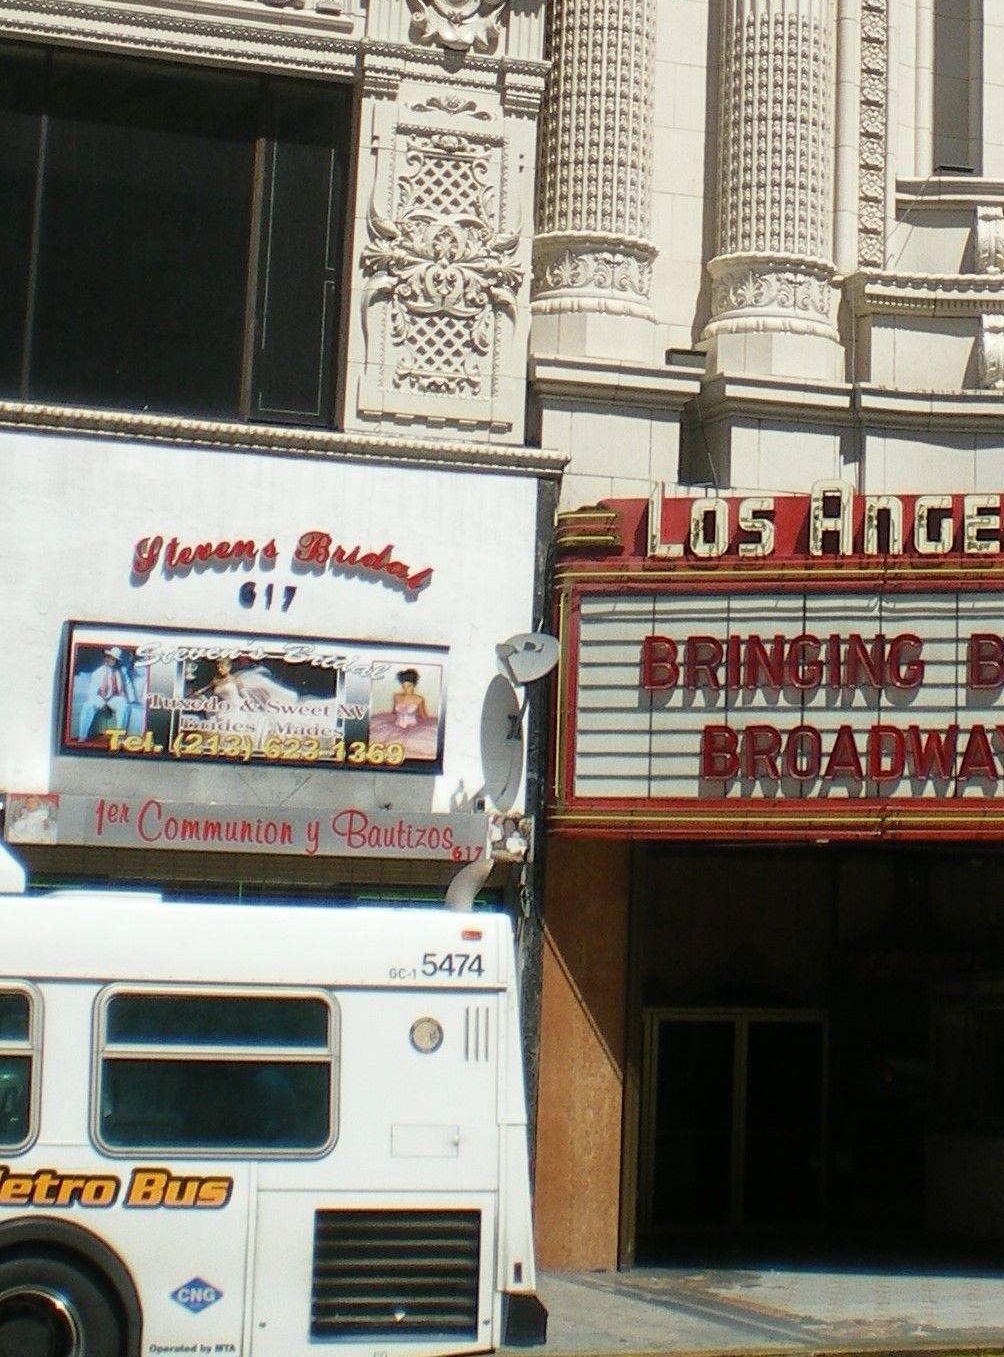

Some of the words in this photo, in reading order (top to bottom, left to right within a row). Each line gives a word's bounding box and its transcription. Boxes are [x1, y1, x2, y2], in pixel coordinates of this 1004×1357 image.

[647, 481, 776, 558] LOS
[295, 531, 434, 590] Bridal
[240, 581, 297, 612] 617
[282, 643, 393, 680] Bridal
[643, 633, 924, 691] BRINGING
[146, 692, 231, 713] Tuxedo
[239, 696, 258, 714] &
[266, 697, 330, 717] Sweet
[337, 703, 369, 721] XV
[267, 720, 345, 739] Mades
[105, 729, 163, 755] Tel.
[172, 732, 252, 761] (213)
[264, 737, 406, 766] 623-1369
[137, 799, 293, 844] Communion
[305, 817, 320, 856] y
[332, 809, 453, 850] Bautizos
[451, 845, 483, 863] 617
[422, 953, 485, 977] 5474
[0, 1165, 120, 1207] etro
[124, 1168, 233, 1209] Bus
[177, 1286, 216, 1303] CNG
[150, 1344, 197, 1354] Operated
[200, 1344, 212, 1355] by
[215, 1344, 236, 1353] MTA
